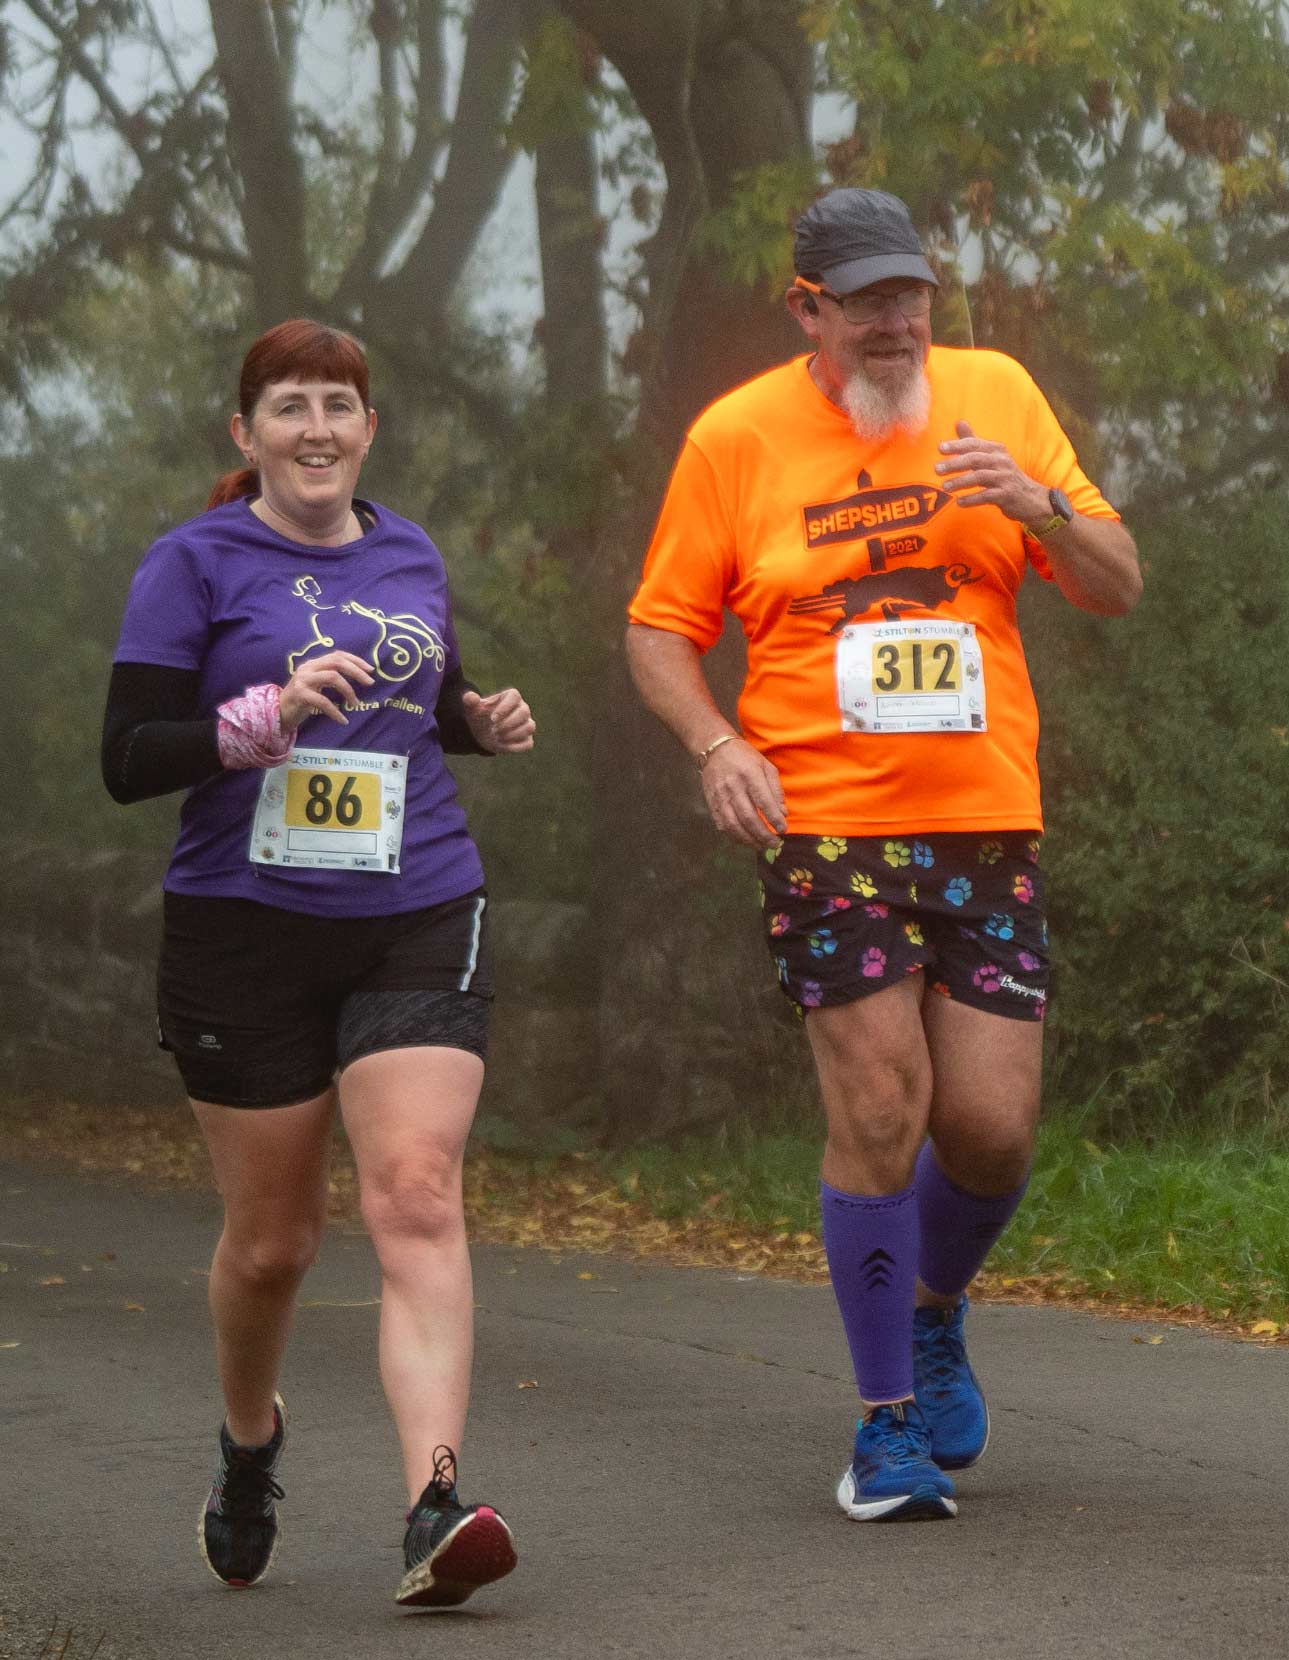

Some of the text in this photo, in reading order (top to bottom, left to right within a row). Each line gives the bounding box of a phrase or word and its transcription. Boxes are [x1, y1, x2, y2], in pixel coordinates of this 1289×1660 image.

[808, 491, 938, 540] SHEPSHED 7
[888, 538, 919, 555] 2021
[876, 643, 956, 692] 312
[302, 755, 384, 769] STILTON STUMBLE
[305, 773, 362, 827] 86
